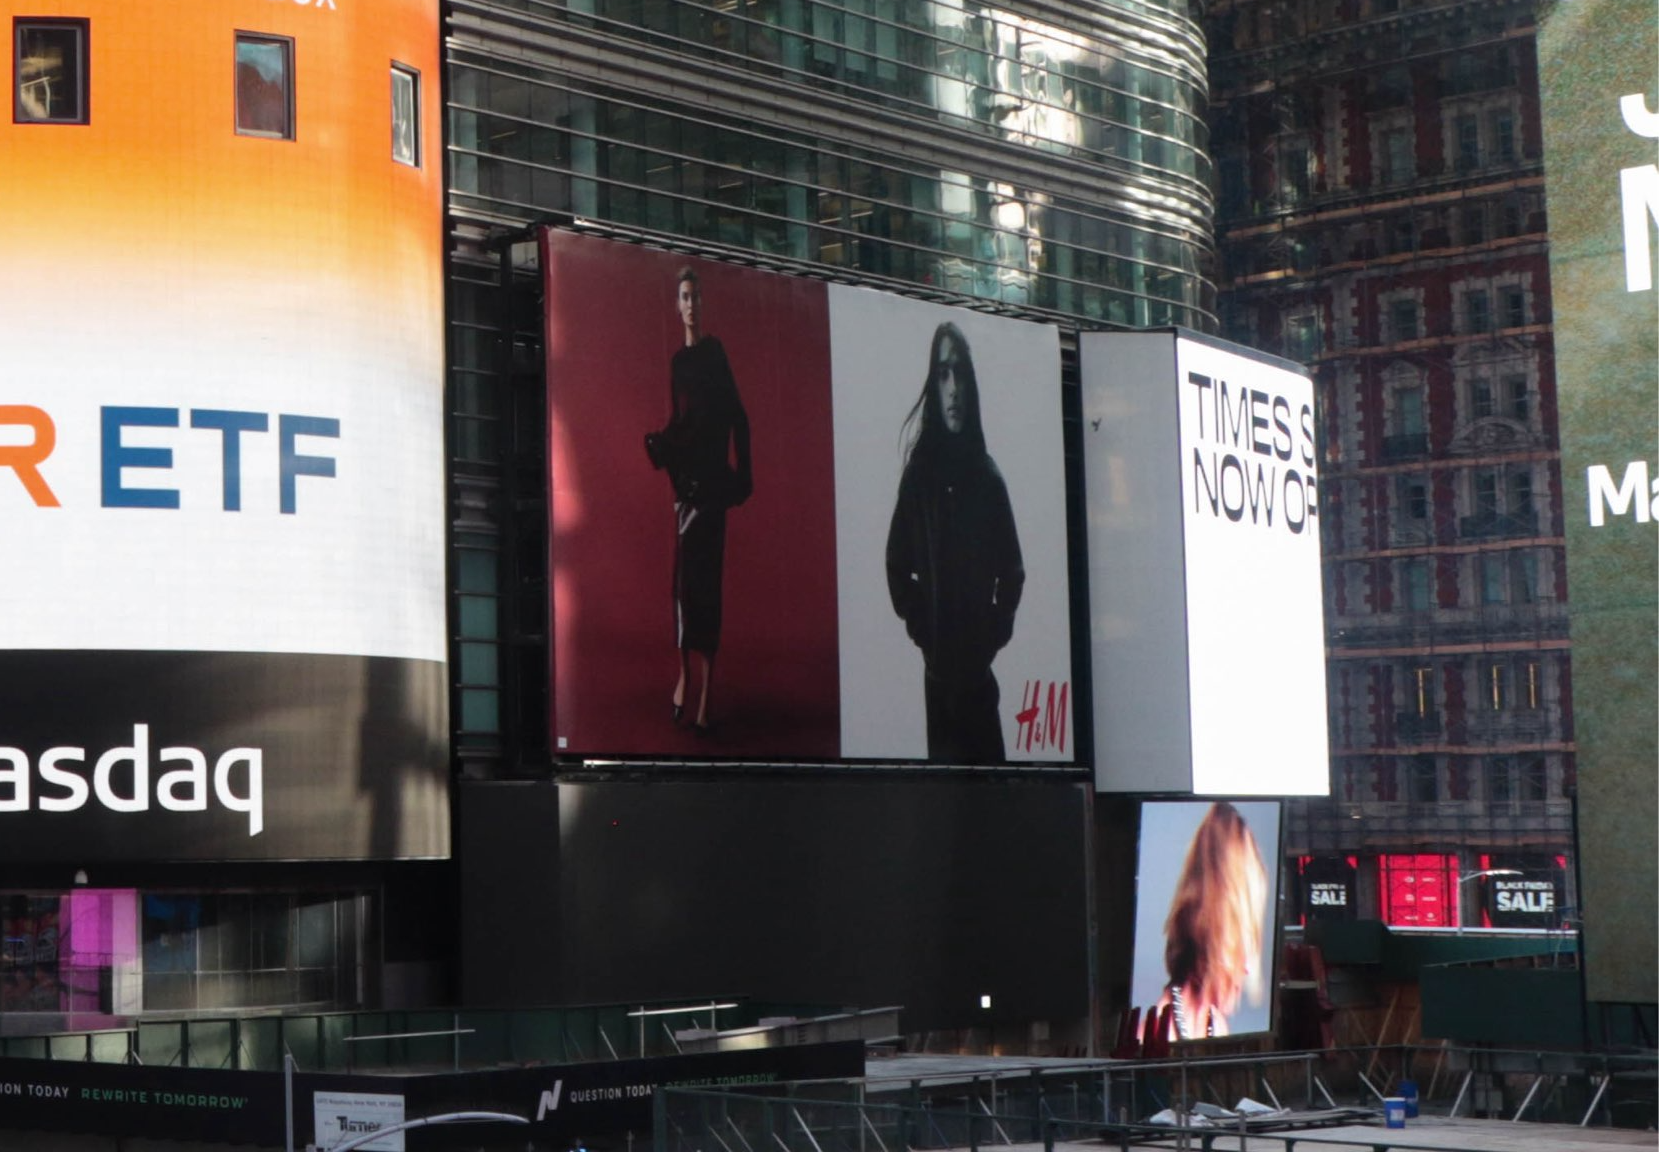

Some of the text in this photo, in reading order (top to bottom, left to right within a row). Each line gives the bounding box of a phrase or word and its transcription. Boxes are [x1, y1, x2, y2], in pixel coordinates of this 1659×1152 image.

[1188, 370, 1293, 462] TIMES
[99, 404, 341, 515] ETF
[1193, 447, 1276, 527] NOW
[1587, 460, 1659, 527] M
[1015, 679, 1069, 755] H&M
[1311, 890, 1346, 905] SALE
[1496, 891, 1554, 912] SALE
[27, 1084, 69, 1098] TODAY
[81, 1087, 147, 1103] REWRITE
[570, 1087, 621, 1103] QUESTION
